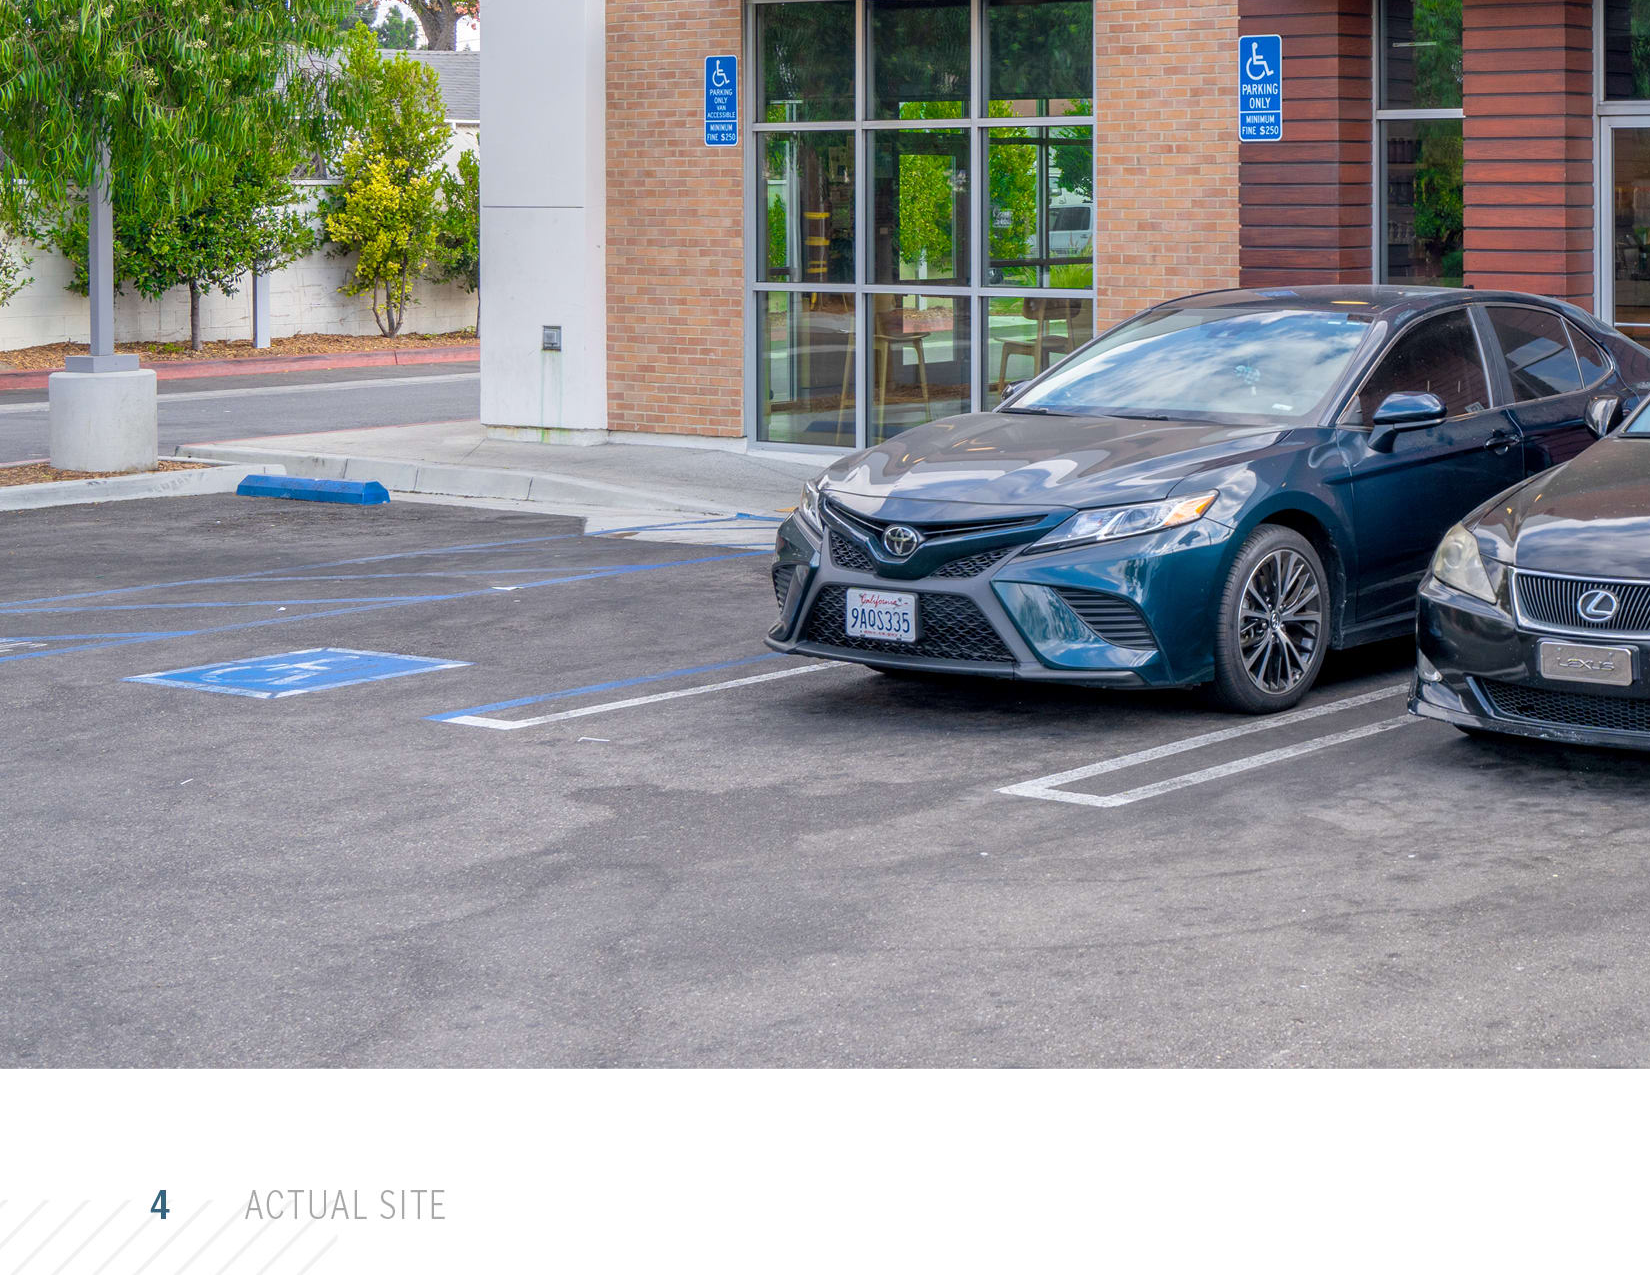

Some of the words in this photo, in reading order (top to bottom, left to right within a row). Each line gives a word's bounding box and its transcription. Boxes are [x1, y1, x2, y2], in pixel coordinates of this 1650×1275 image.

[709, 88, 733, 96] PARKING
[1242, 83, 1279, 95] PARKING
[1249, 97, 1271, 109] ONLY
[1246, 115, 1275, 124] MINIMUM
[709, 124, 733, 132] MINIMUM
[1242, 127, 1257, 135] FINE
[1259, 126, 1279, 135] $250
[860, 593, 902, 608] California
[851, 607, 911, 634] 9AQS335
[1557, 657, 1615, 671] LEXUS
